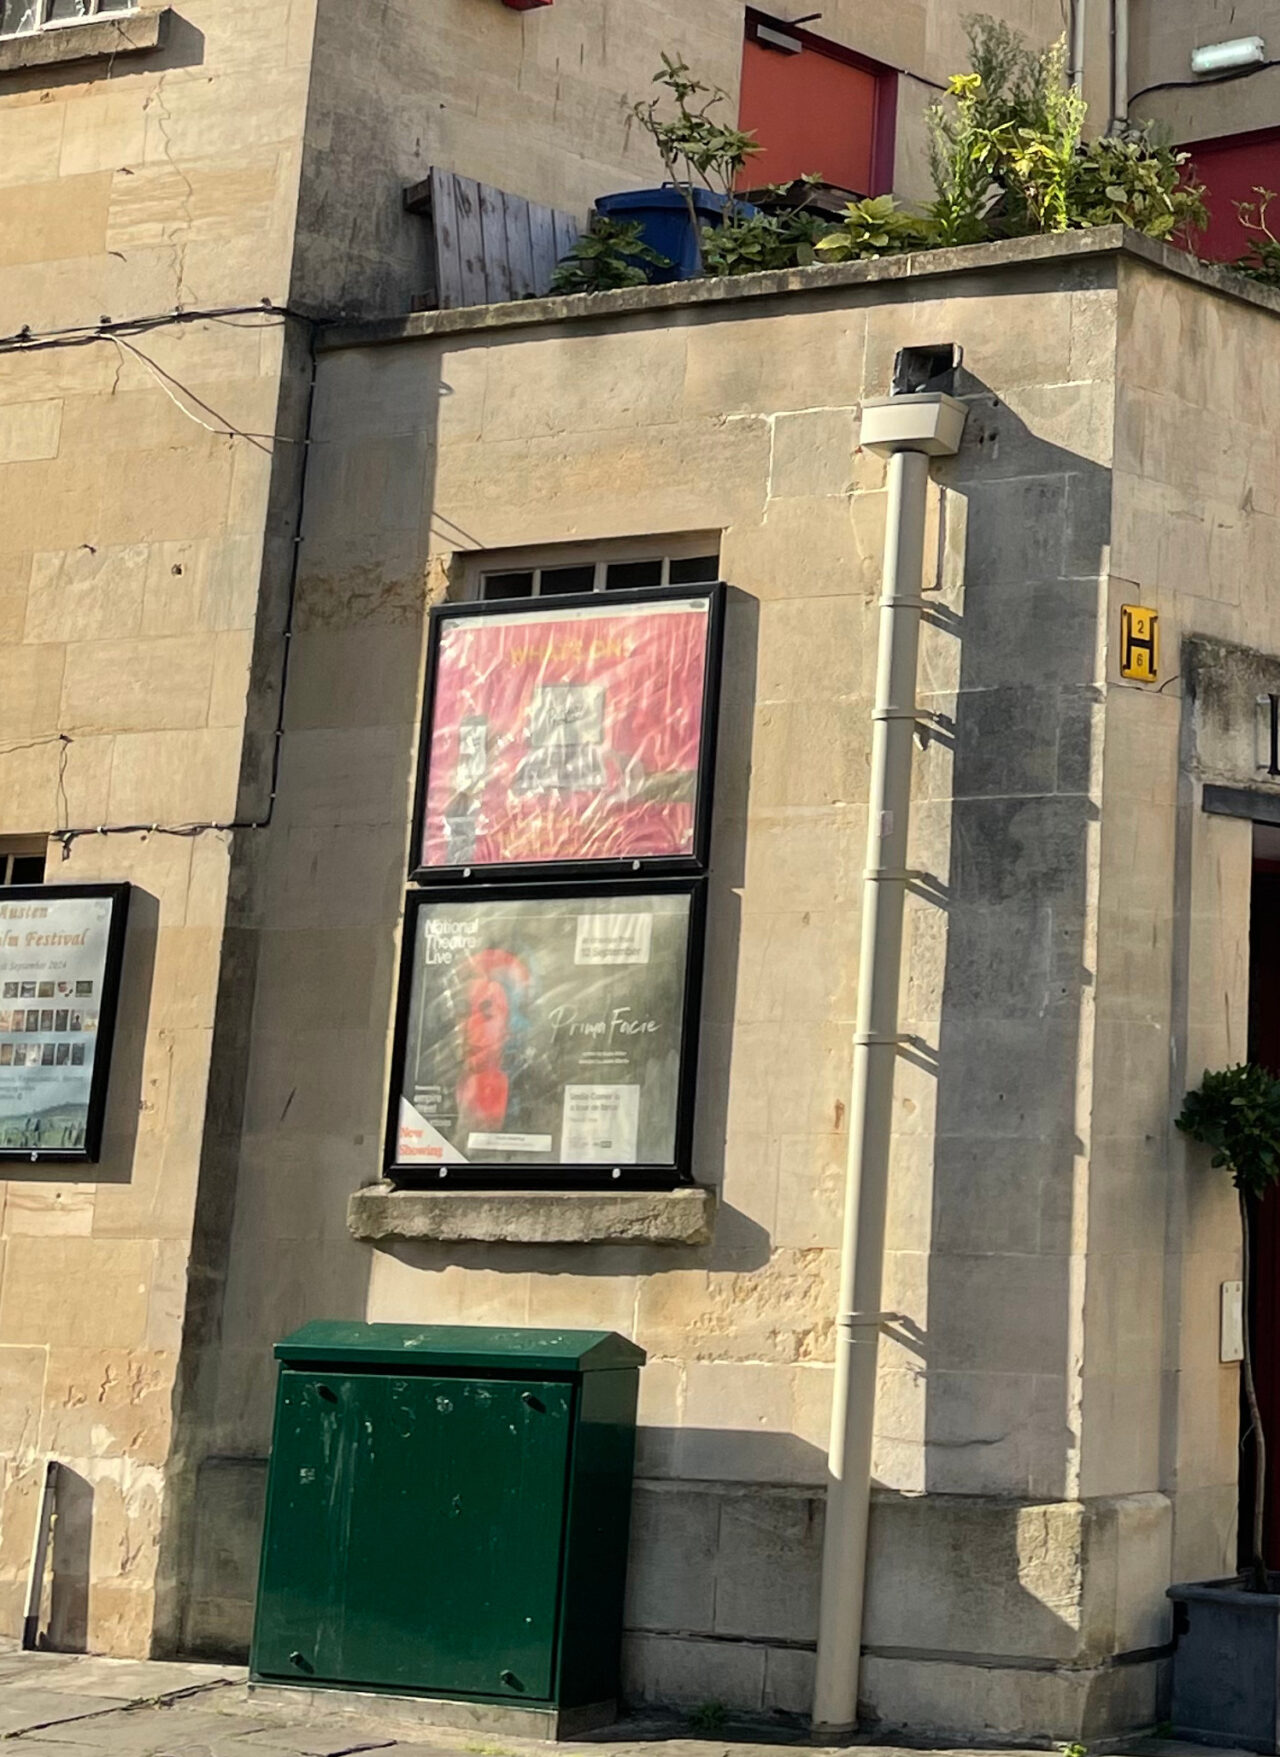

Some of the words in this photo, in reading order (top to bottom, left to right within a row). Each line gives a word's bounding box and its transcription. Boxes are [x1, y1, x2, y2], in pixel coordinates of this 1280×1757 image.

[1138, 619, 1144, 634] 2
[1126, 612, 1155, 675] H
[1136, 653, 1143, 667] 6
[425, 918, 479, 937] National
[25, 928, 90, 947] Festival
[427, 935, 477, 950] Theatre
[426, 951, 452, 964] Live
[548, 1004, 607, 1044] Prima
[608, 1006, 661, 1044] Facie
